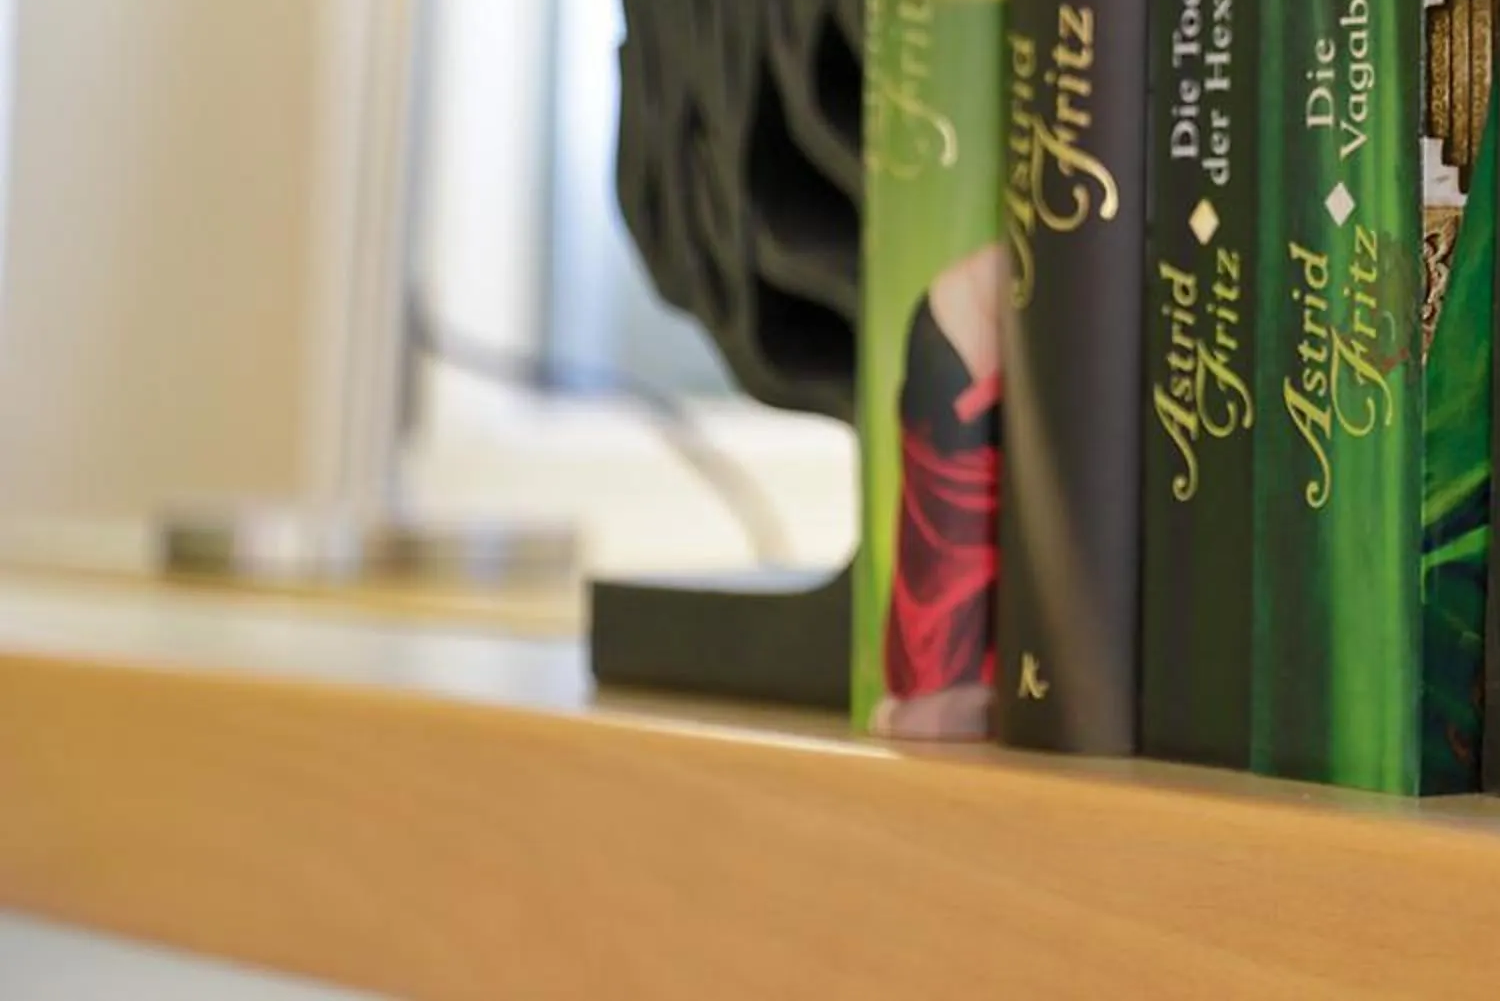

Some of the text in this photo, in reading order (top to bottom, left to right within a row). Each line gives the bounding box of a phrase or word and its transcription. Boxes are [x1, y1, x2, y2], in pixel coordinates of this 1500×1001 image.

[1031, 3, 1118, 233] Fritz
[1171, 78, 1197, 160] Die
[1200, 109, 1231, 186] der
[1306, 36, 1336, 128] Die
[1153, 262, 1199, 501] Astrid
[1197, 246, 1254, 437] Fritz
[1283, 242, 1332, 509] Astrid
[1329, 224, 1393, 437] Fritz
